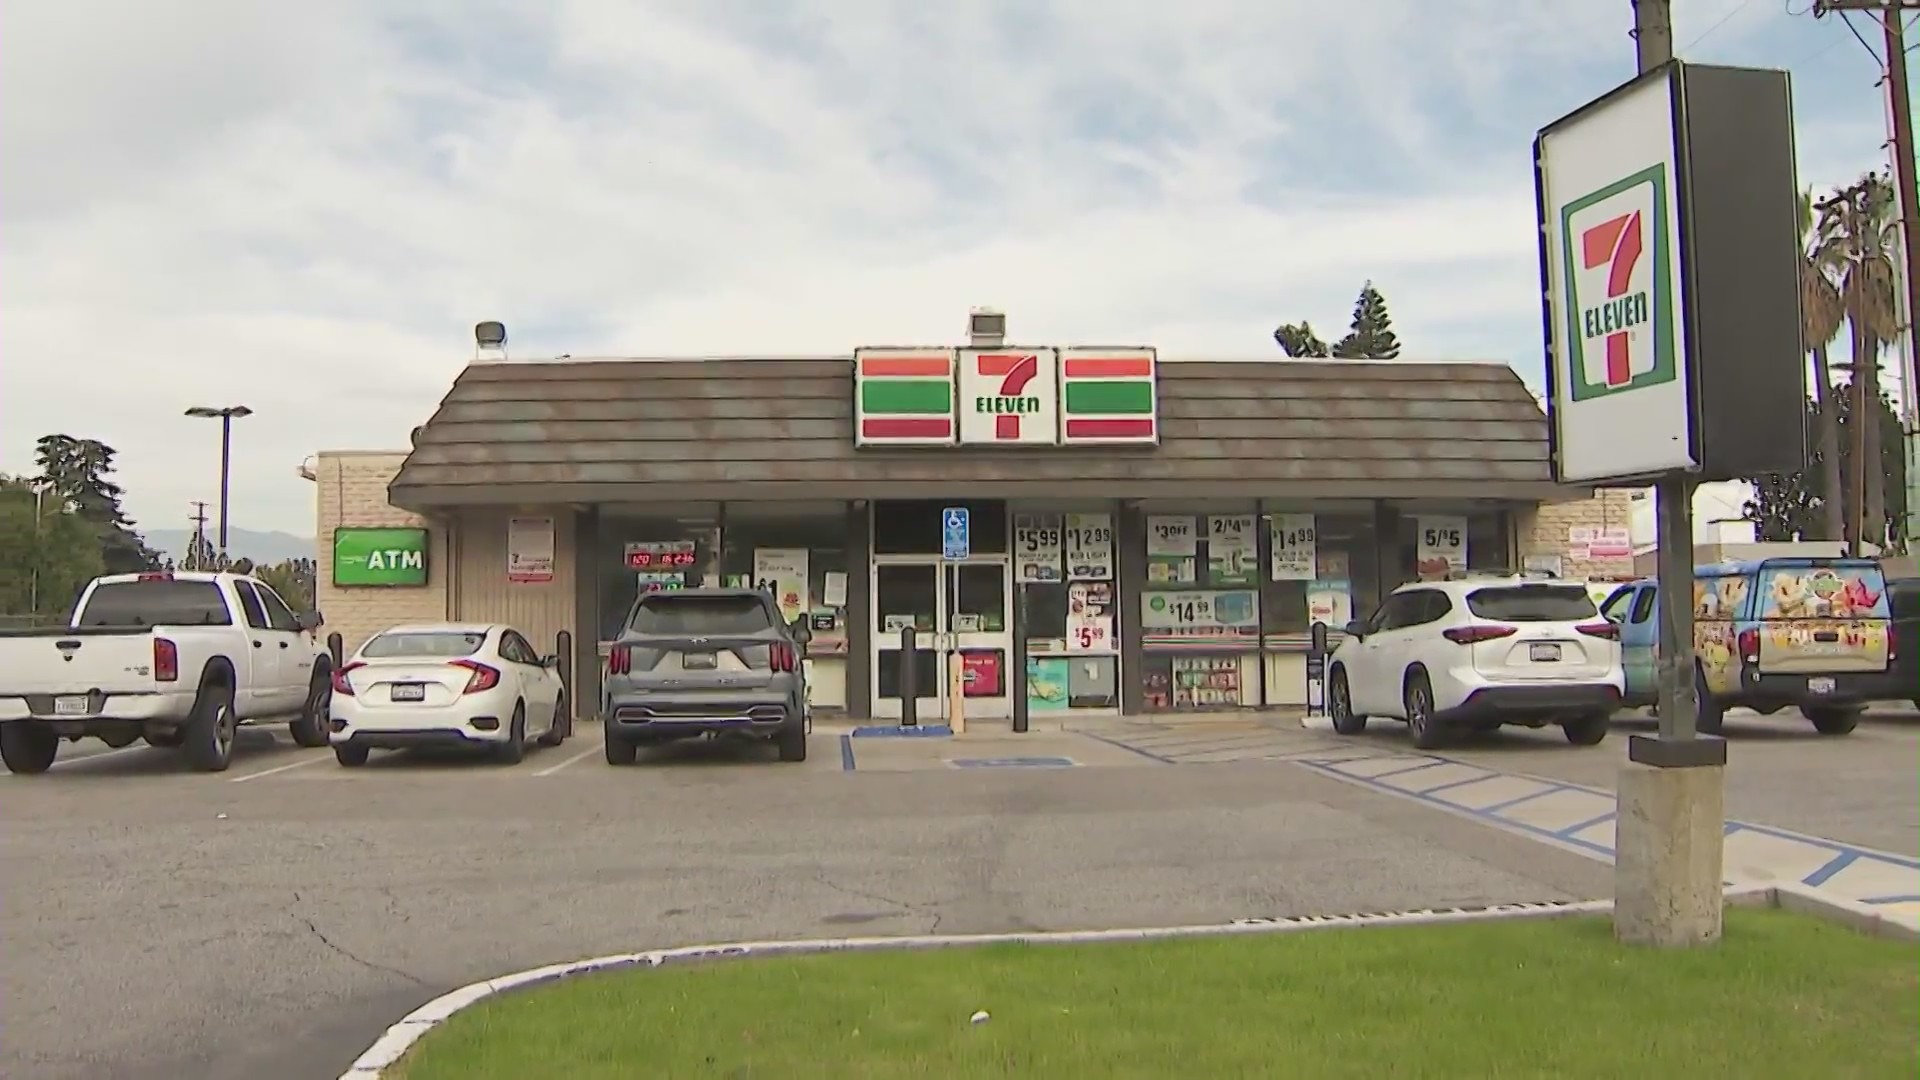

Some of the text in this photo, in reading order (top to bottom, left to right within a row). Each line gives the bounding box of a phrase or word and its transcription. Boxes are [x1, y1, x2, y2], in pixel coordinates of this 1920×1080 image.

[1583, 209, 1642, 385] 7
[977, 355, 1037, 438] 7
[367, 549, 423, 570] ATM
